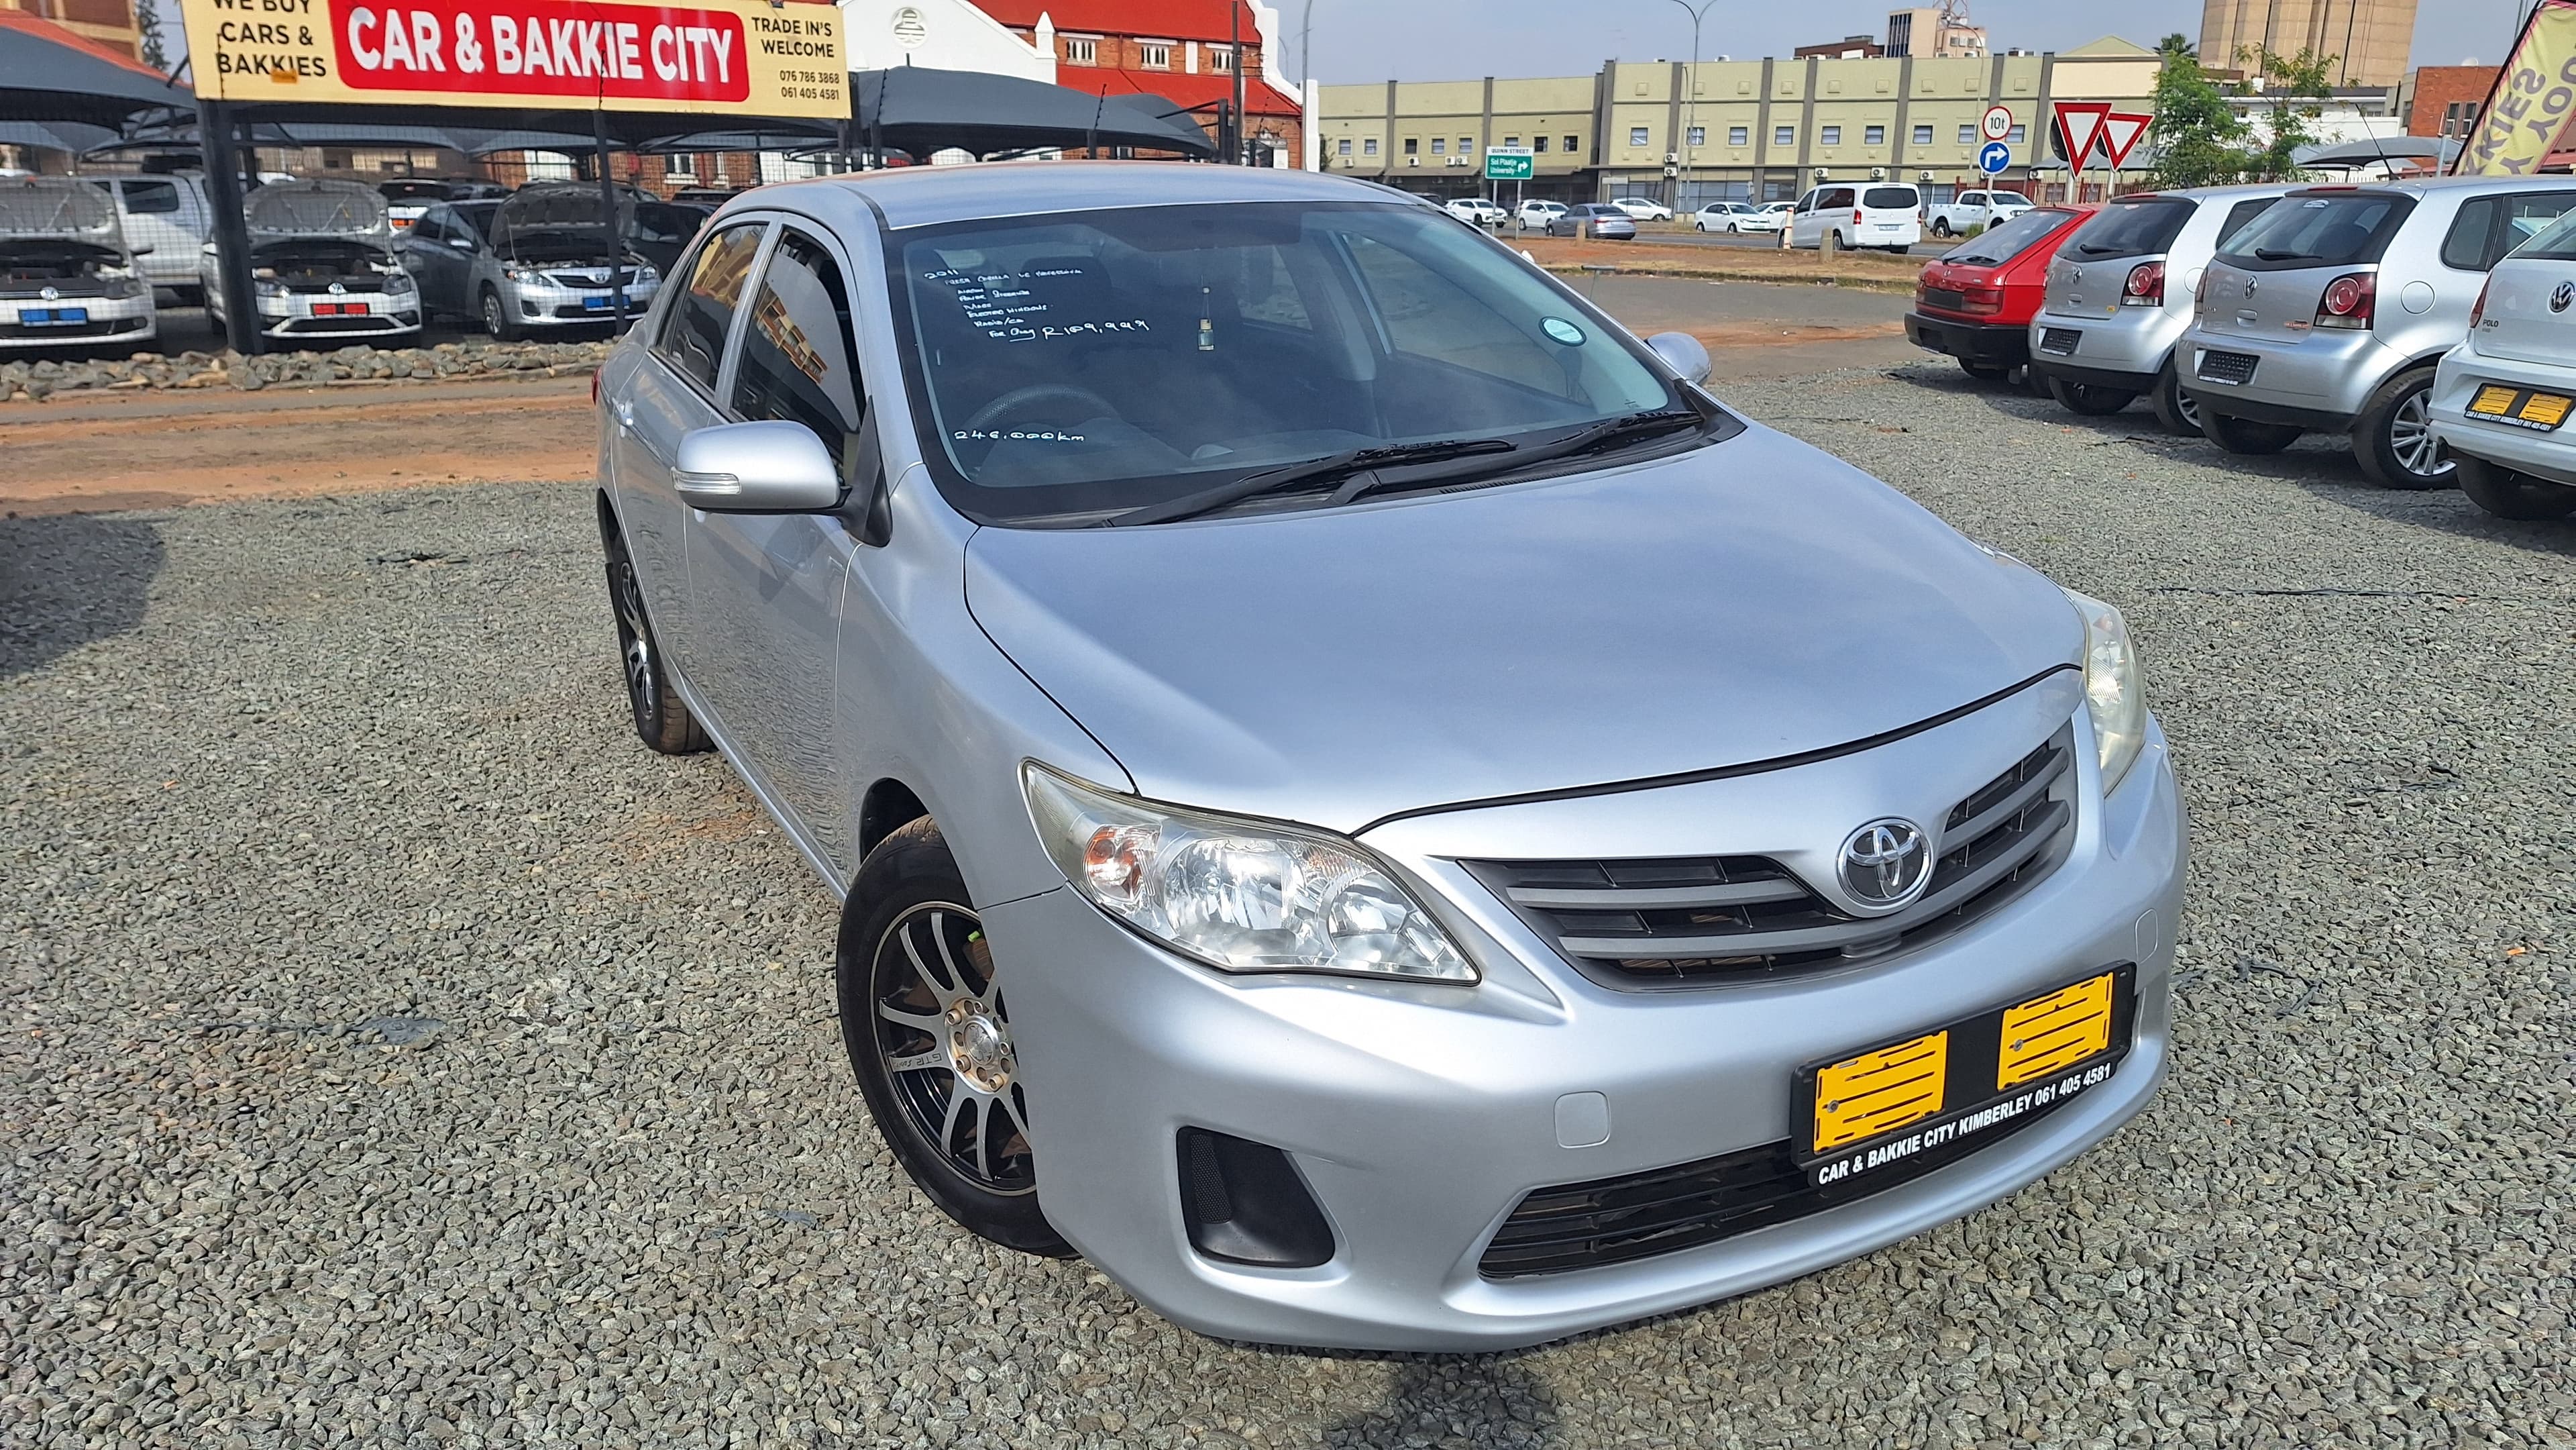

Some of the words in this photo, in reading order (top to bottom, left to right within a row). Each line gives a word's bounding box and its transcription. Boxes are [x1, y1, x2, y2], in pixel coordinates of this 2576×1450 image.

[220, 21, 290, 44] CARS
[298, 26, 314, 46] &
[751, 16, 801, 34] TRADE
[806, 20, 833, 36] IN'S
[347, 7, 446, 72] CAR
[455, 12, 484, 73] &
[490, 15, 644, 79] BAKKIE
[650, 24, 733, 83] CITY
[761, 38, 835, 58] WELCOME
[215, 52, 327, 77] BAKKIES
[780, 70, 797, 81] 076
[798, 71, 816, 83] 786
[781, 87, 798, 98] 061
[799, 88, 817, 99] 405
[819, 89, 839, 100] 4581
[924, 269, 959, 279] 2011
[1006, 304, 1046, 313] WINDOWS
[2483, 319, 2499, 327] POLO
[1819, 1159, 1849, 1185] CAR
[1852, 1155, 1864, 1174] &
[1867, 1134, 1921, 1168] BAKKIE
[1924, 1121, 1957, 1148] CITY
[1958, 1092, 2033, 1135] KIMBERLEY
[2035, 1084, 2056, 1106] 061
[2059, 1074, 2081, 1096] 405
[2082, 1062, 2111, 1086] 4581
